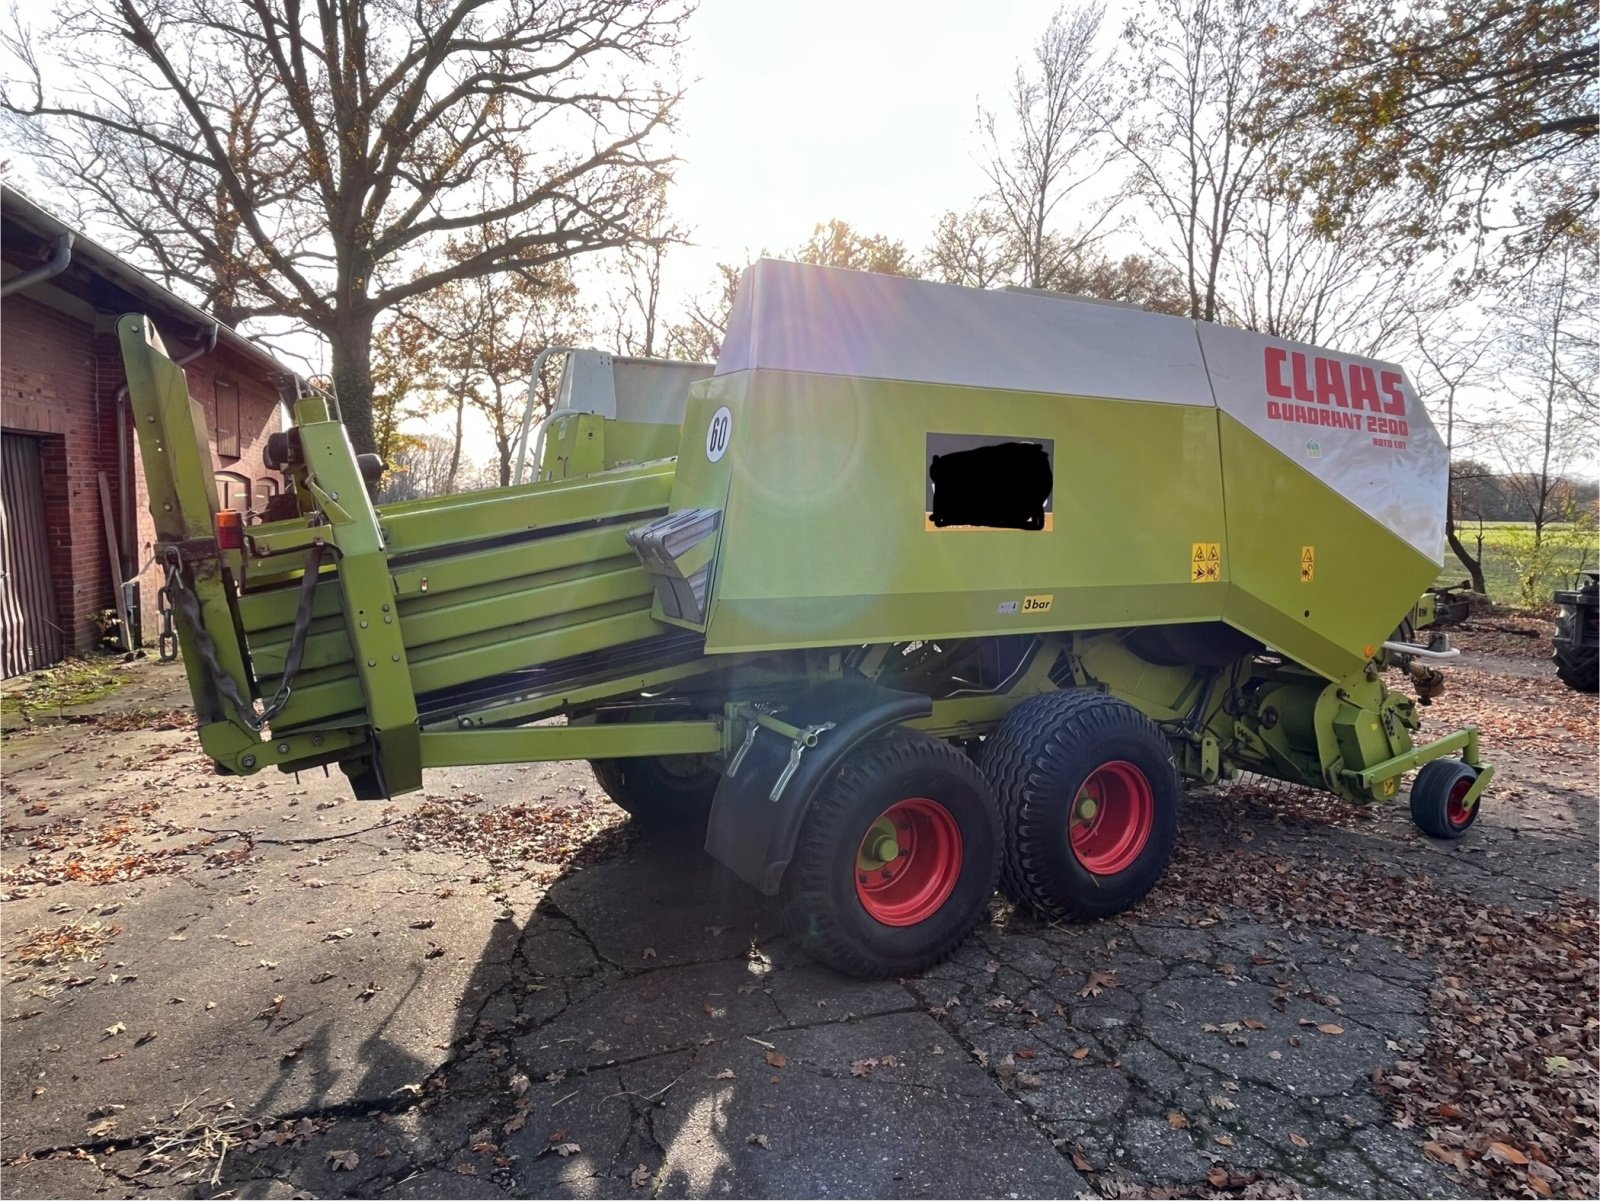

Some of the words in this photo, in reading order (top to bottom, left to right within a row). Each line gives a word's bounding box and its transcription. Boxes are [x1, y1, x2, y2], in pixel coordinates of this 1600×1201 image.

[1264, 346, 1406, 417] CLAAS
[709, 416, 728, 452] 60
[1267, 401, 1363, 431] QUADRANT
[1367, 416, 1409, 437] 2200
